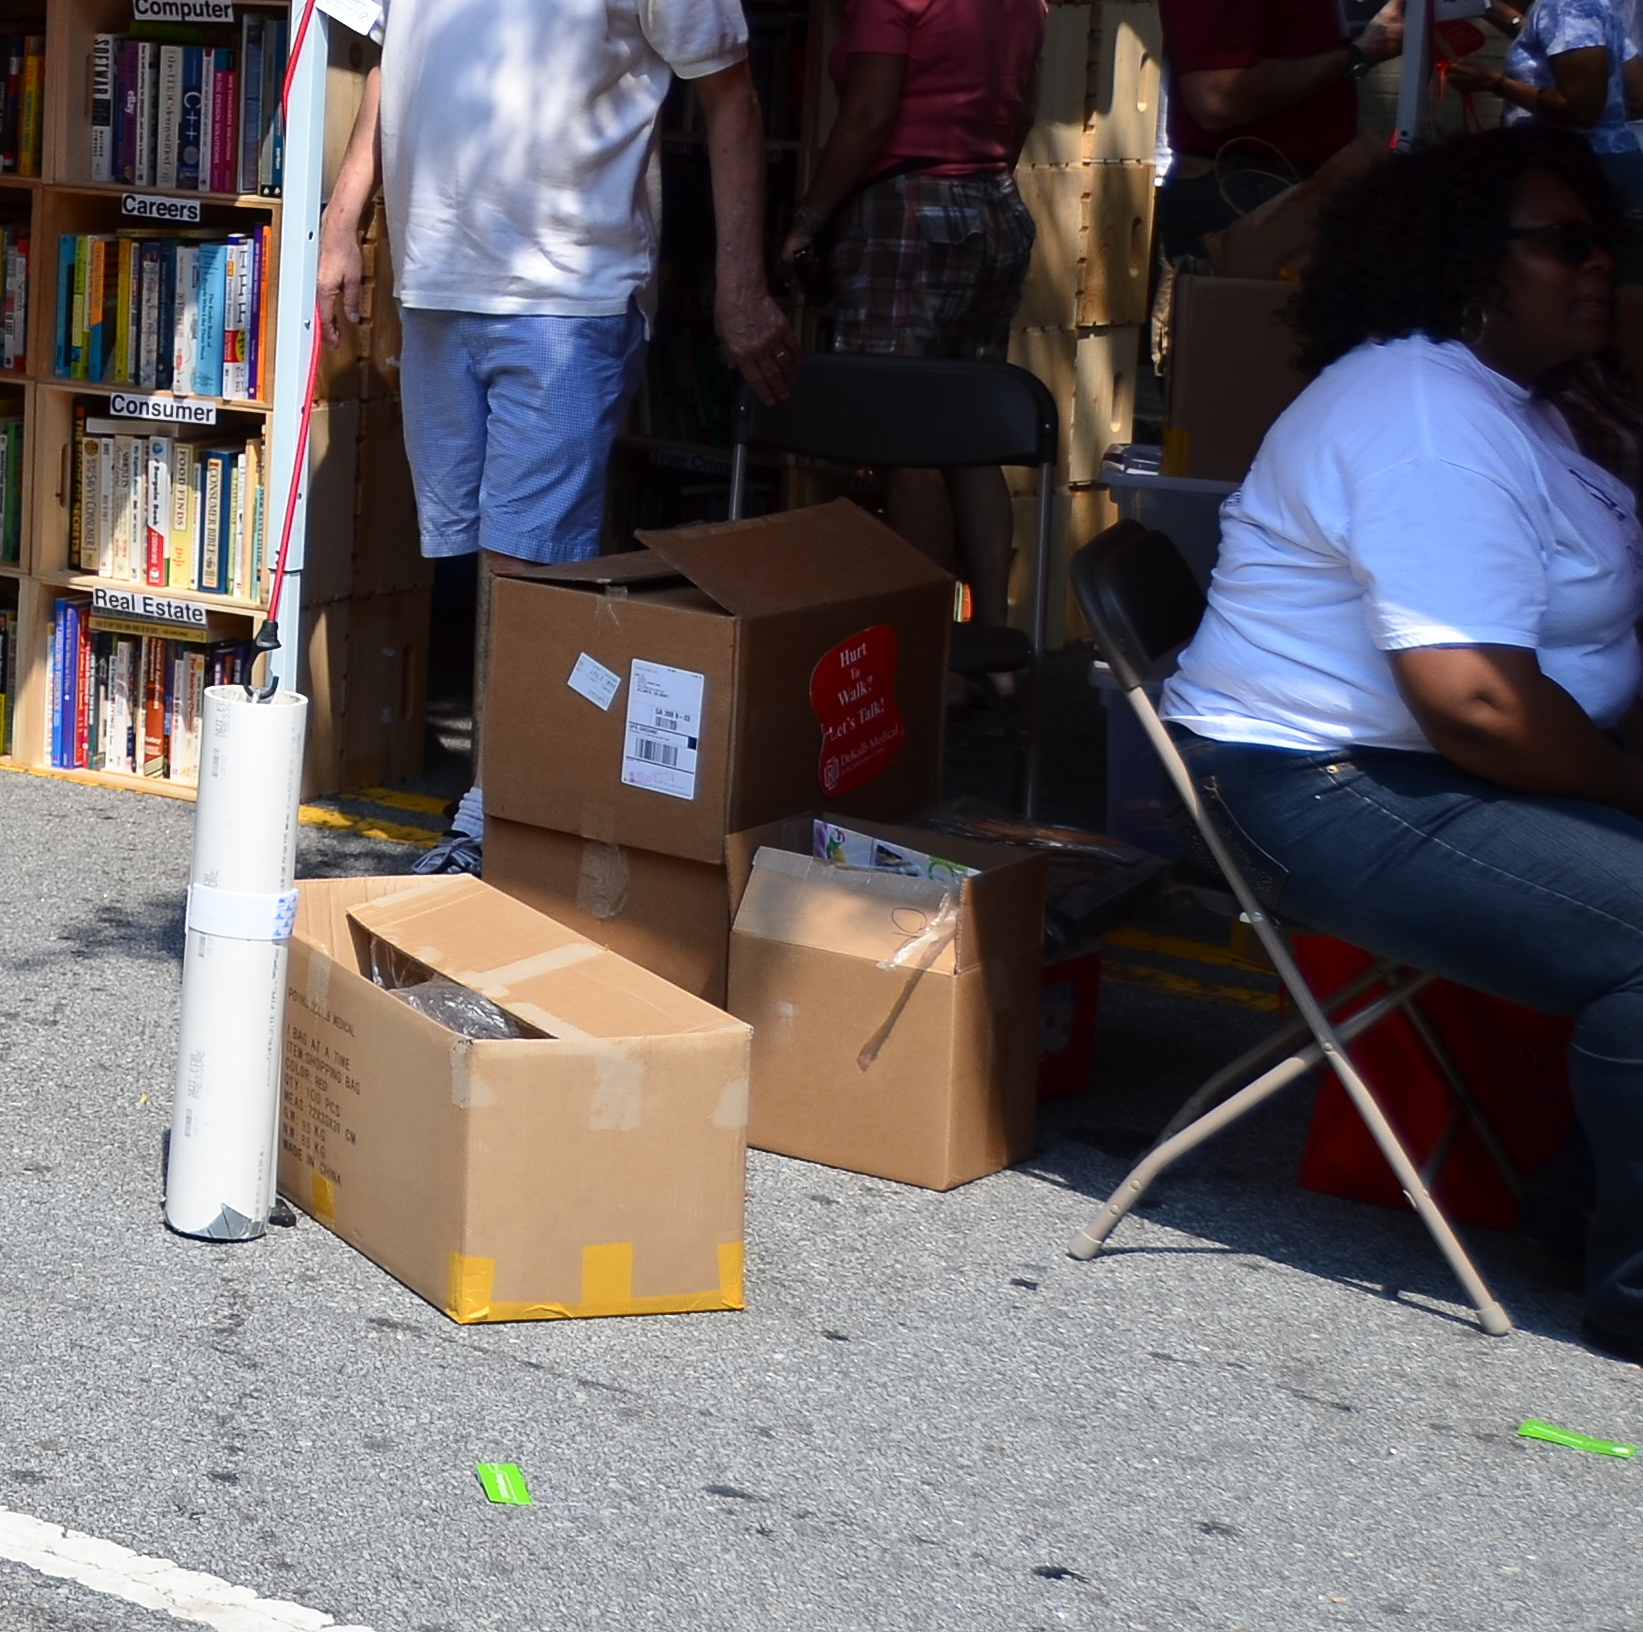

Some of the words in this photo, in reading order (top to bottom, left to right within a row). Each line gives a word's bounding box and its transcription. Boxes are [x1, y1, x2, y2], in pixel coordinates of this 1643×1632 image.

[125, 90, 135, 114] eBay
[183, 91, 201, 141] C++
[213, 123, 221, 164] SOLUTIONS
[123, 196, 199, 221] Careers
[111, 396, 214, 425] Consumer
[152, 466, 160, 501] Bargain
[177, 450, 187, 485] FOOD
[176, 490, 186, 526] FINDS
[206, 468, 218, 526] CONSUMER
[83, 501, 97, 546] CONSUMER
[205, 527, 217, 556] BIBLE
[94, 587, 136, 613] Real
[142, 595, 204, 623] Estate
[839, 641, 867, 668] Hurt
[837, 674, 874, 707] Walk?
[849, 667, 861, 681] To
[827, 716, 856, 743] Let's
[857, 696, 886, 726] Talk!
[840, 740, 869, 766] DeKalb
[869, 722, 900, 747] Medical
[291, 1027, 307, 1046] BAG
[310, 1039, 321, 1053] AT
[324, 1047, 331, 1058] A
[334, 1051, 351, 1072] TIME
[345, 1076, 361, 1095] BAG
[325, 1097, 341, 1118] PCS
[283, 1139, 303, 1162] MADE
[306, 1154, 315, 1168] IN
[320, 1163, 342, 1187] CHINA
